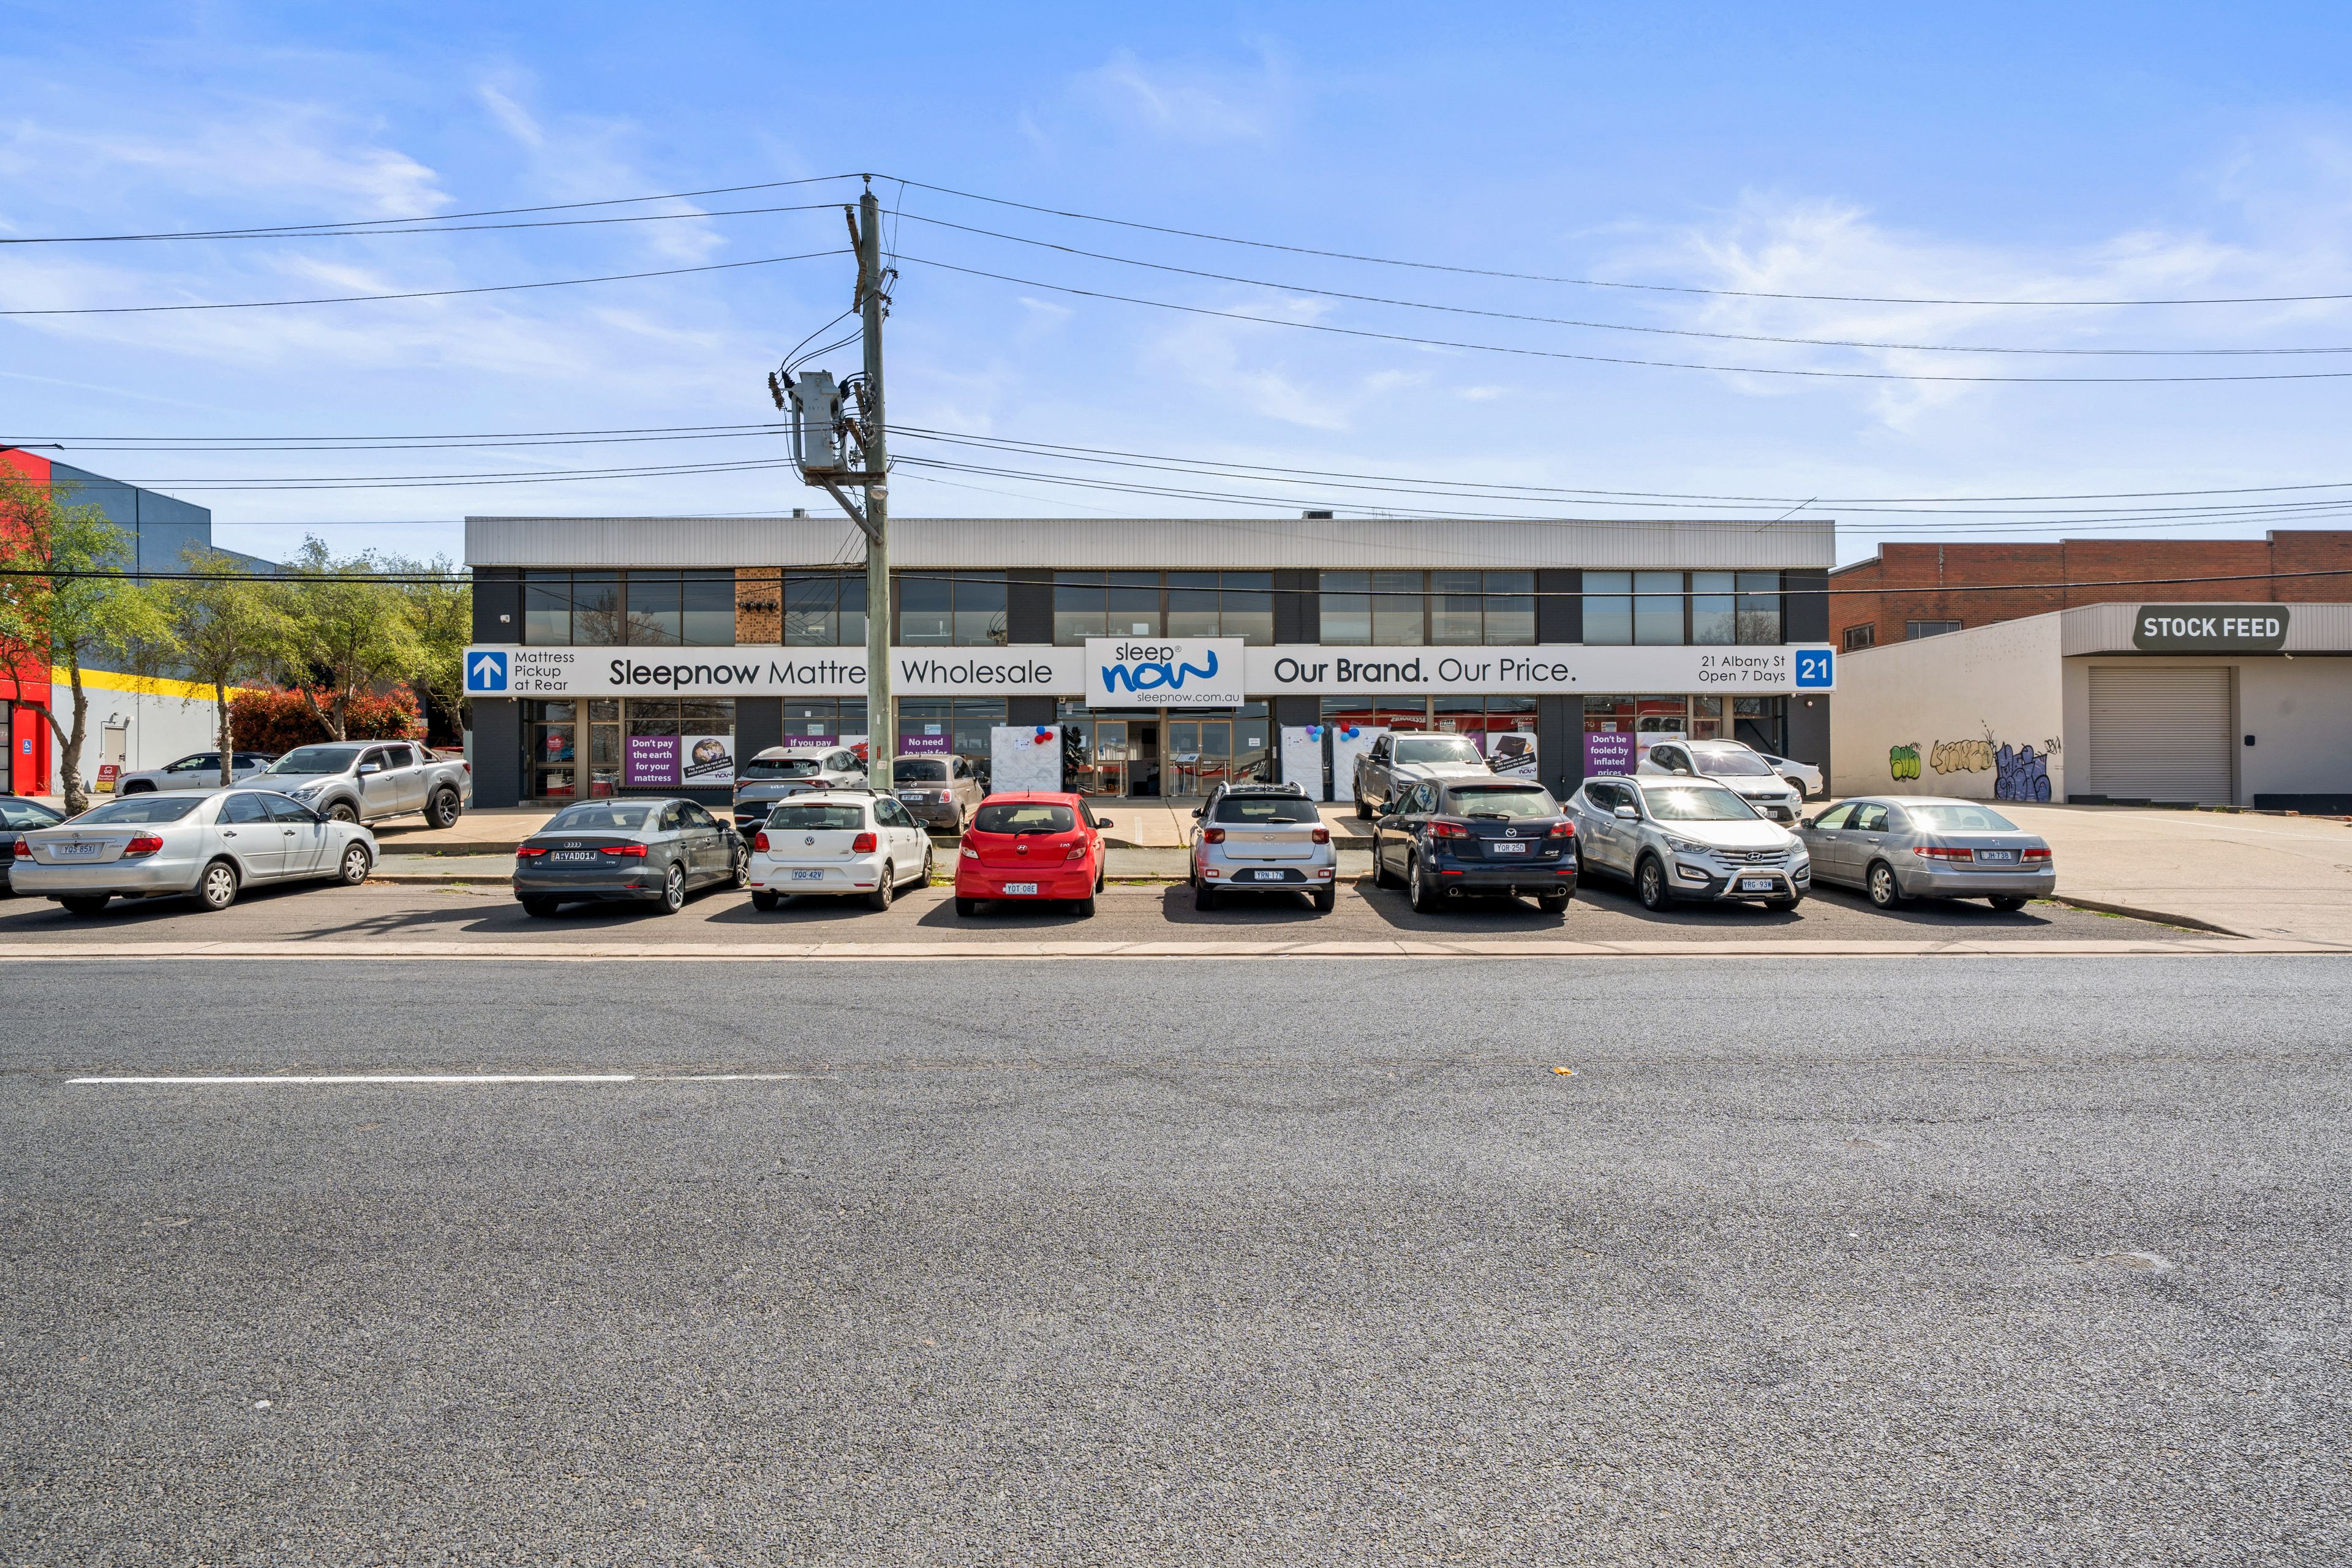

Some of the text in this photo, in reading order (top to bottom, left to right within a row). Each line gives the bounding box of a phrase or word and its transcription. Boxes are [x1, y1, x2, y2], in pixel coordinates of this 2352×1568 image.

[2144, 617, 2280, 637] STOCK FEED
[515, 651, 575, 663] Mattress
[1702, 655, 1785, 669] 21 Albany St
[515, 665, 561, 679] Pickup
[609, 659, 1053, 690] Sleepnow Mattre Wholesale
[1101, 649, 1218, 693] now
[1274, 657, 1577, 683] Our Brand. Our Price.
[1801, 658, 1827, 679] 21
[1698, 670, 1785, 684] Open 7 Days
[515, 680, 568, 690] at Rear
[1137, 692, 1240, 704] sleepnow.com.au
[1618, 746, 1629, 756] by
